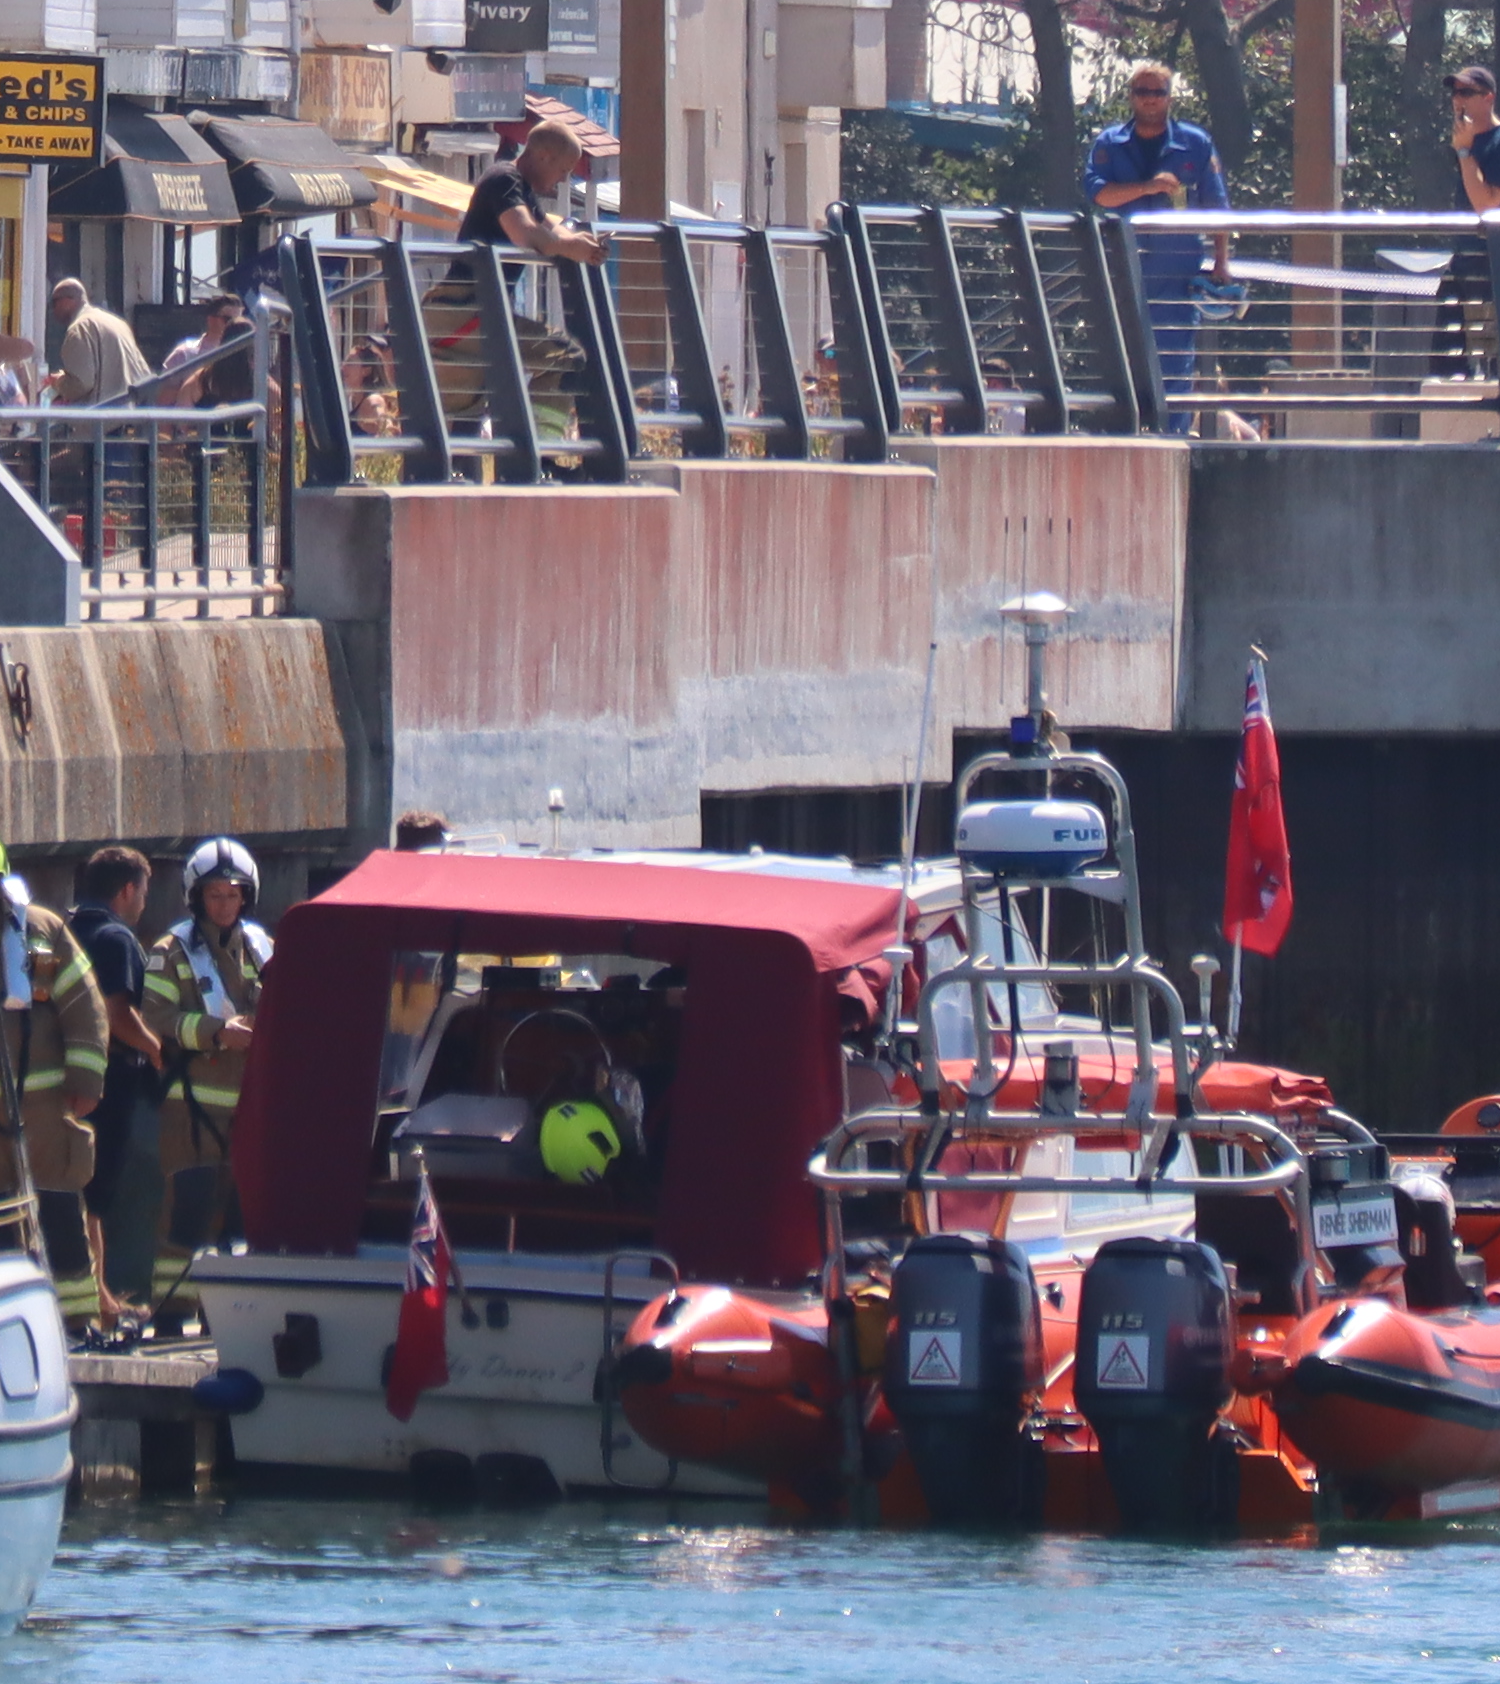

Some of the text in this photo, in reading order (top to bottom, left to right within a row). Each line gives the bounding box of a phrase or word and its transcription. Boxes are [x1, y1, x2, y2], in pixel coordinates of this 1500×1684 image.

[4, 105, 18, 120] &
[25, 105, 88, 122] CHIPS
[6, 135, 45, 149] TAKE
[49, 137, 91, 151] AWAY
[1053, 828, 1104, 842] FUR
[1348, 1208, 1391, 1234] SHERMAN
[915, 1312, 957, 1326] 115
[1102, 1314, 1143, 1329] 115
